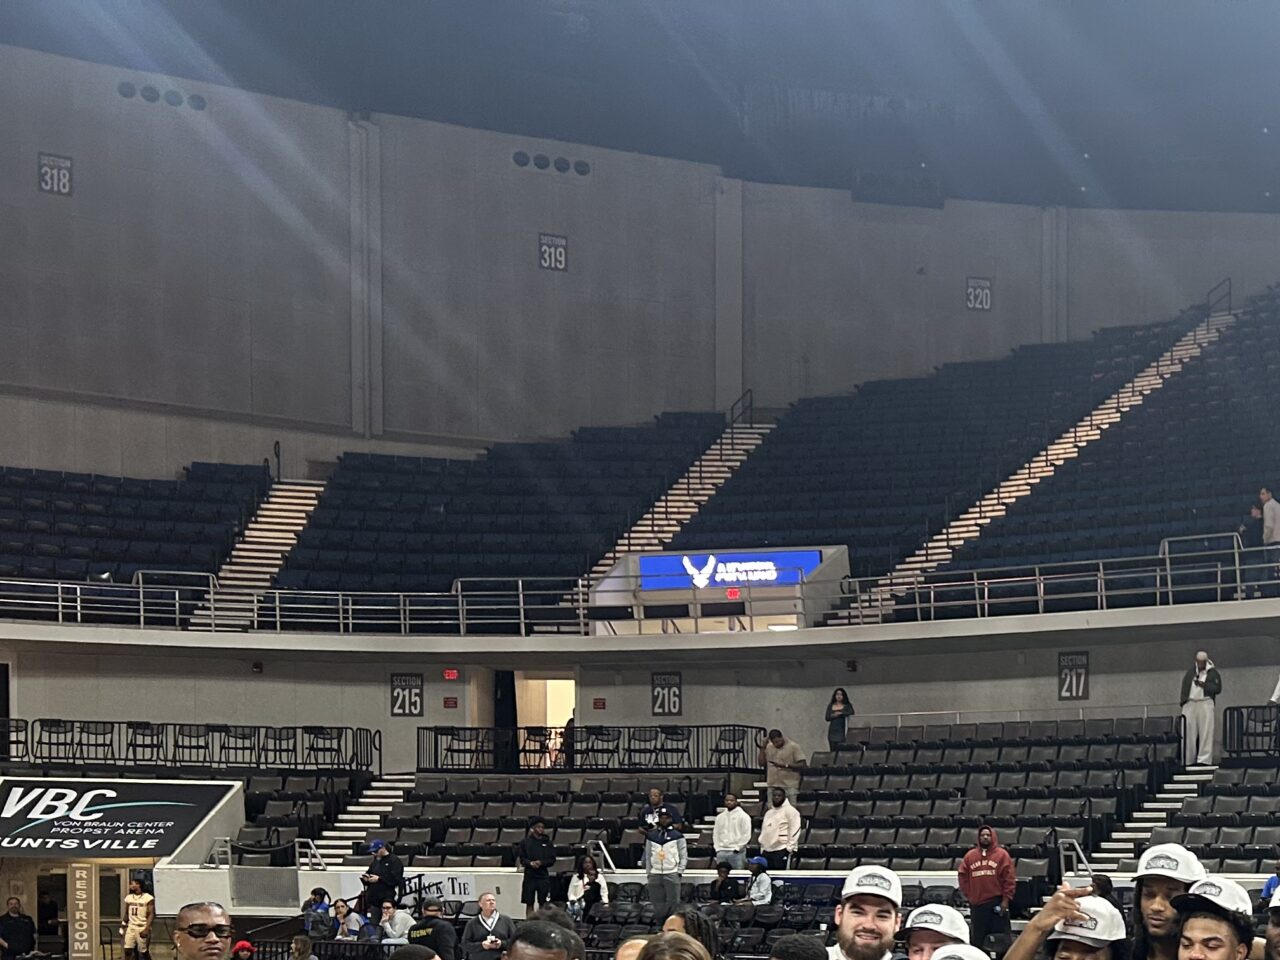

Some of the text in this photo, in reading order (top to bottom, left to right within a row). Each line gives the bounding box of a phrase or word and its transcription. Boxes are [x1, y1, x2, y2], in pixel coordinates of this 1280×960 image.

[41, 166, 69, 193] 318
[541, 246, 566, 269] 319
[967, 288, 990, 309] 320
[1060, 654, 1087, 666] SECTION
[393, 675, 422, 686] SECTION
[654, 674, 681, 684] SECTION
[1061, 669, 1086, 697] 217
[393, 689, 421, 714] 215
[654, 687, 680, 713] 216
[0, 787, 117, 821] VBC
[50, 827, 166, 837] PROPST ARENA
[53, 820, 176, 830] VON BRAUN CENTER
[0, 837, 159, 850] UNTSVILLE
[73, 869, 90, 951] RESTROOM
